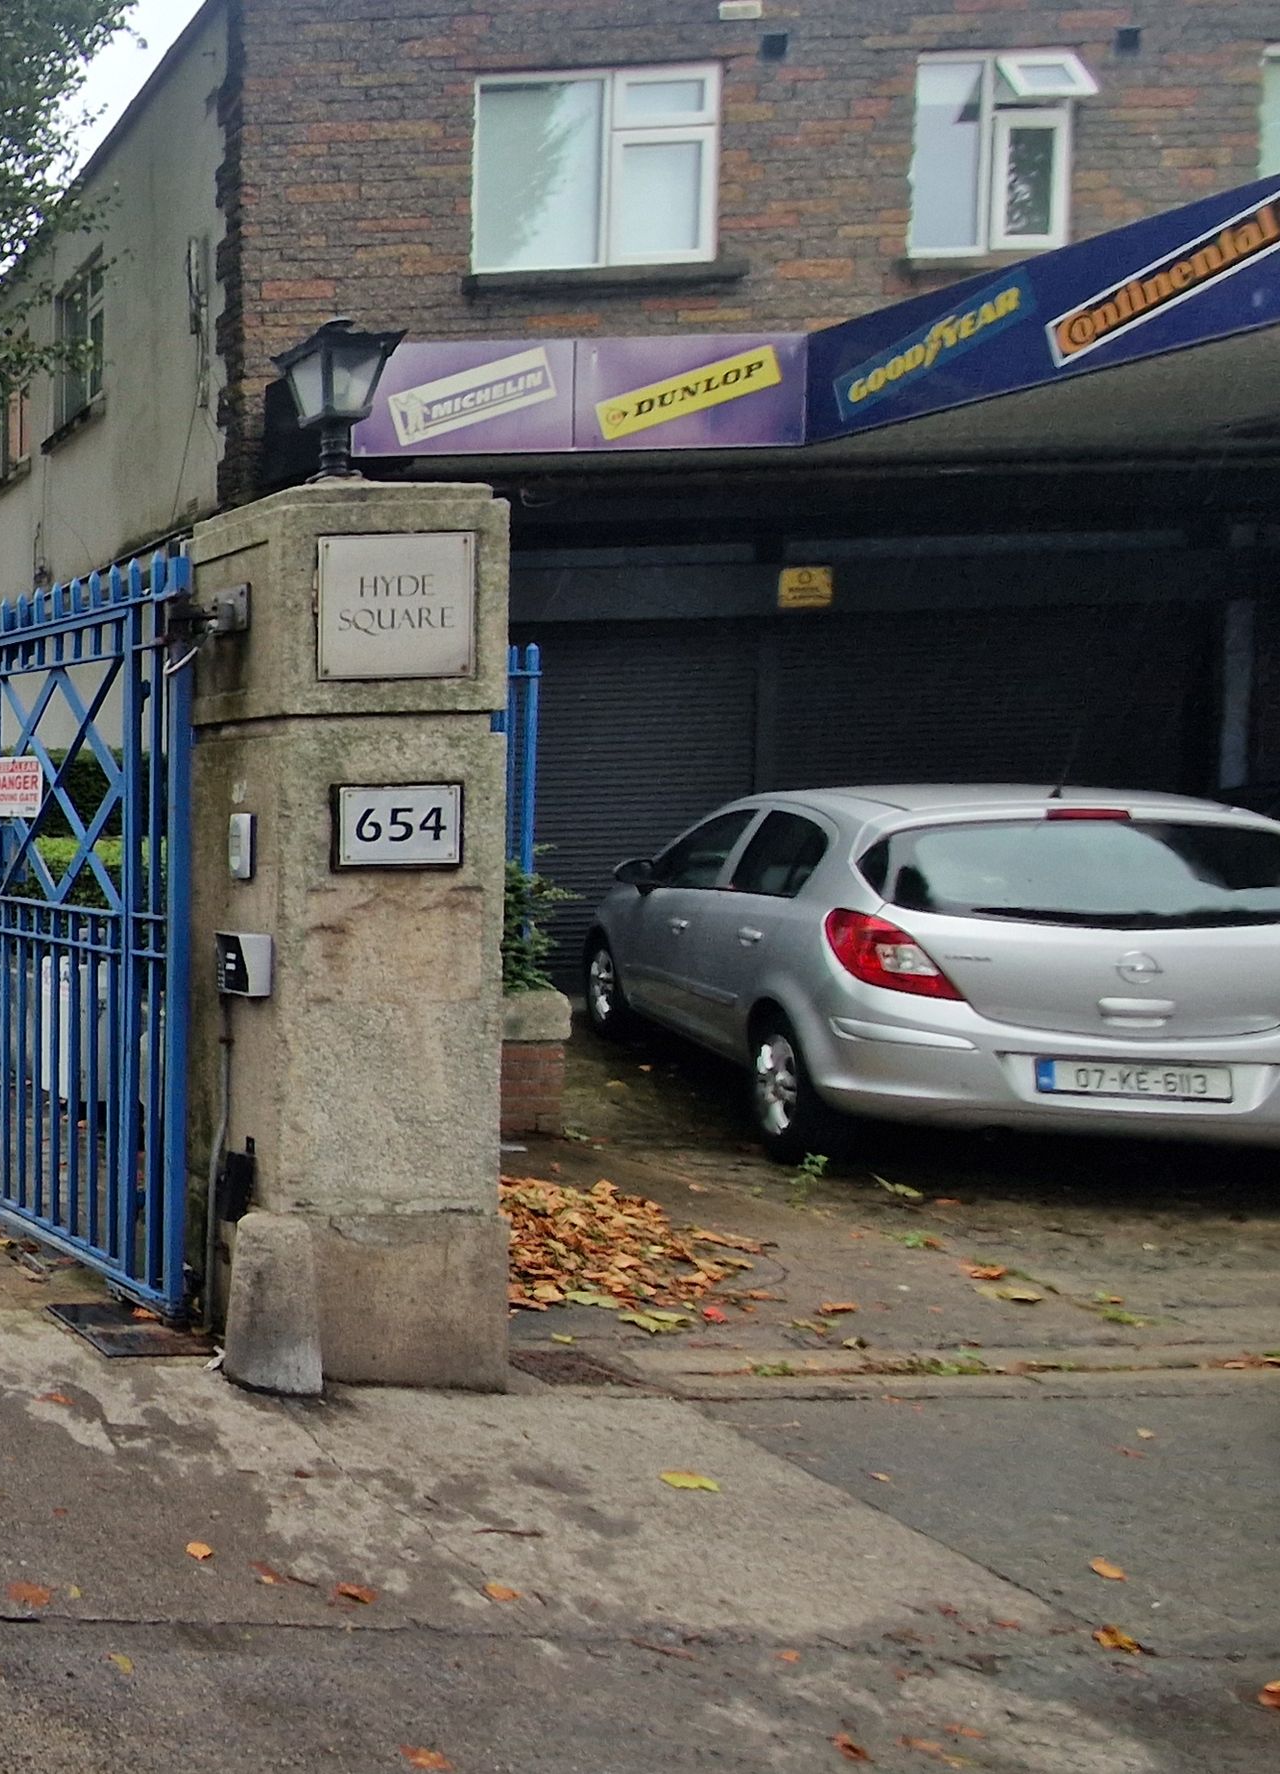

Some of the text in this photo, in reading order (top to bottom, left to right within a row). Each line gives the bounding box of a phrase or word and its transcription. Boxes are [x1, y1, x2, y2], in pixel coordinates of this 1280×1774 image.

[847, 287, 1021, 403] GOODYEAR
[429, 369, 544, 420] MICHELIN
[633, 360, 764, 417] DUNLOP
[359, 574, 436, 598] HYDE
[338, 607, 455, 636] SQUARE
[19, 792, 38, 801] GATE
[355, 807, 447, 842] 654
[1075, 1068, 1208, 1094] 07-KE-6113
